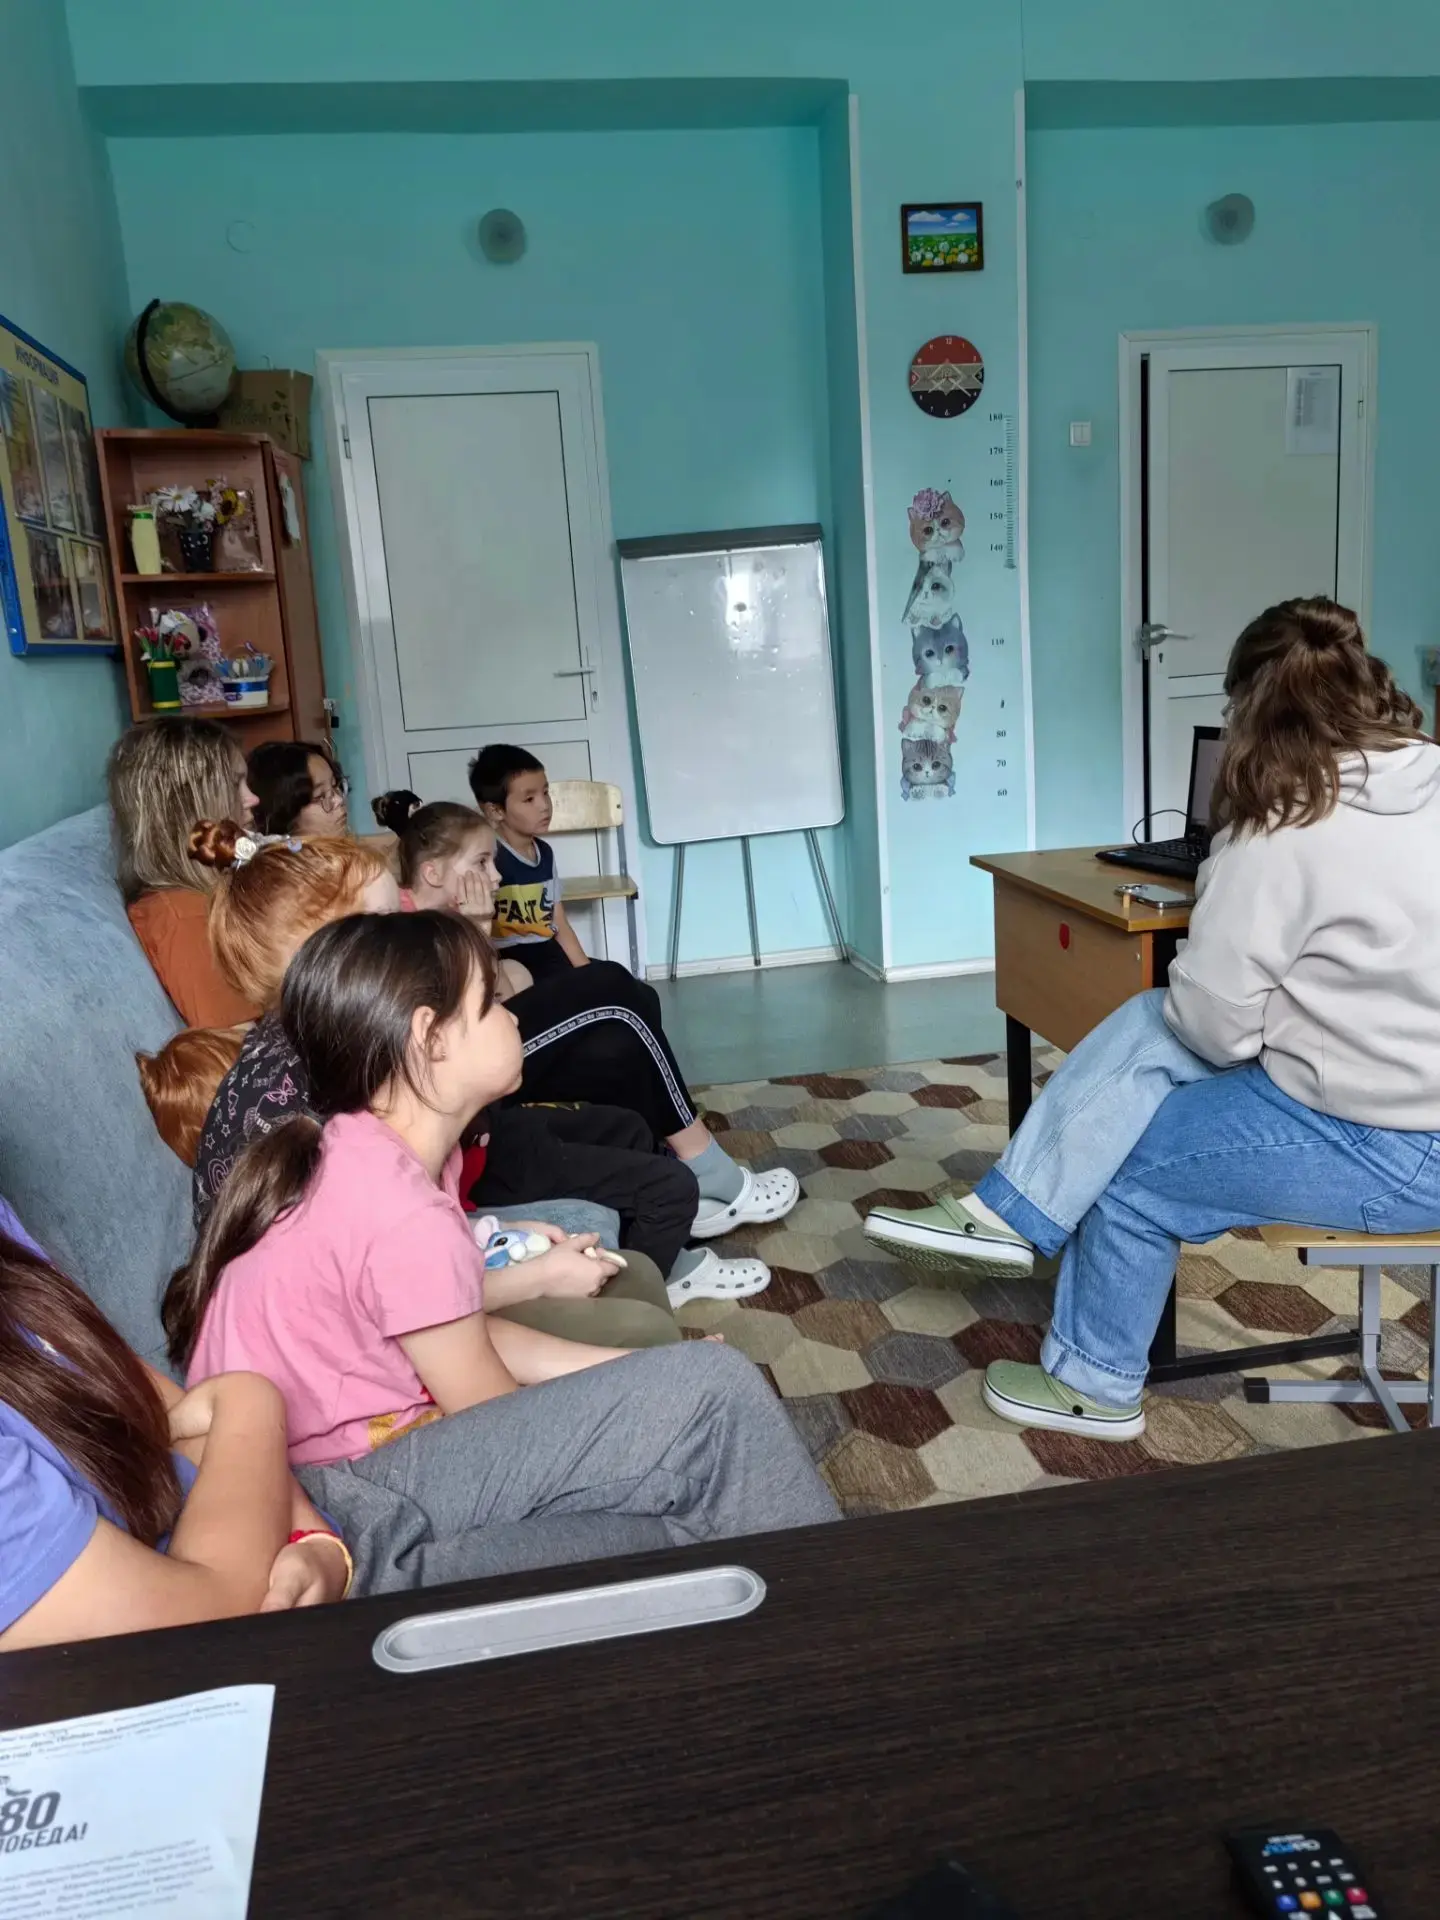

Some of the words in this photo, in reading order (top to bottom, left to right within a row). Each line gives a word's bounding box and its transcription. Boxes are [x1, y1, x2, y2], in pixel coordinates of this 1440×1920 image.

[989, 413, 1003, 422] 180
[989, 447, 1003, 456] 170
[990, 479, 1003, 487] 160
[990, 544, 1003, 552] 140
[991, 638, 1005, 646] 110
[996, 730, 1006, 738] 80
[996, 759, 1006, 767] 70
[997, 788, 1007, 797] 60
[0, 1790, 61, 1836] 80
